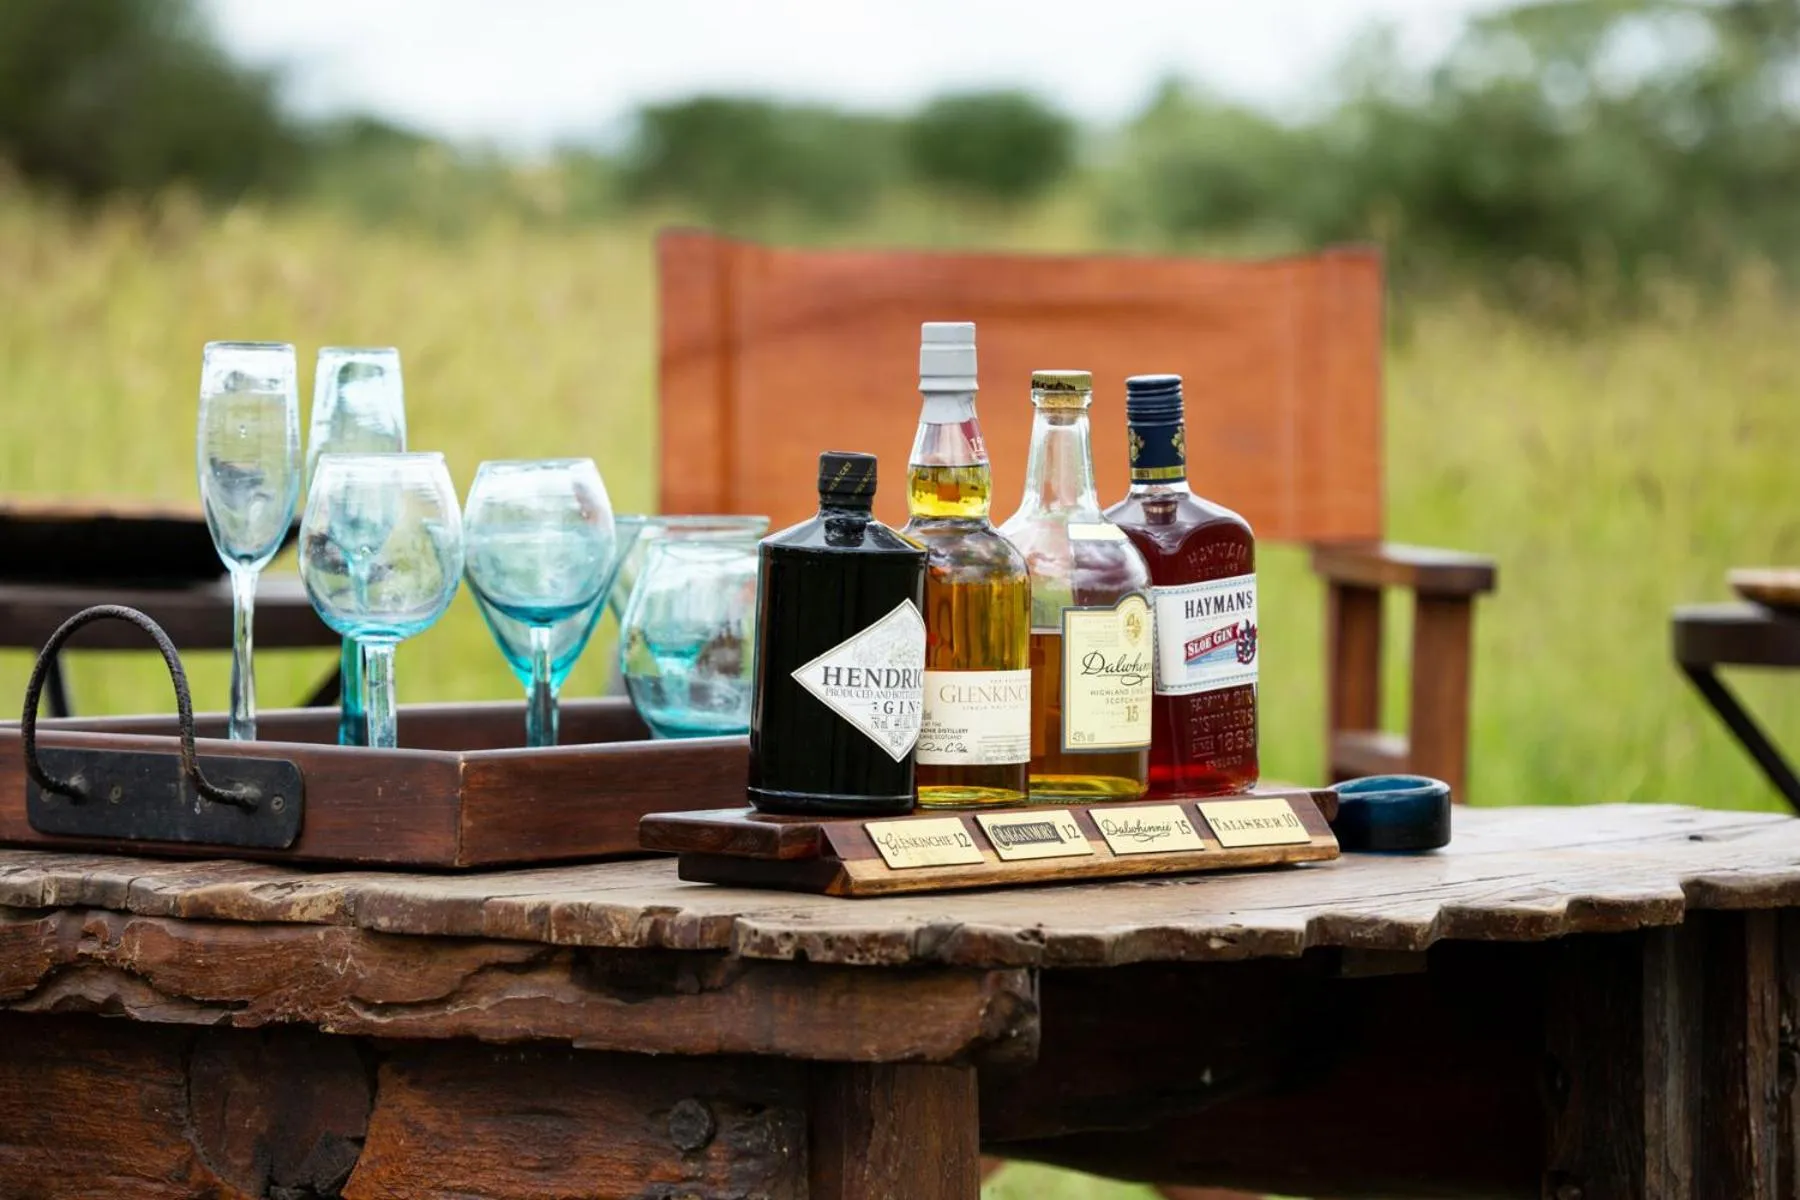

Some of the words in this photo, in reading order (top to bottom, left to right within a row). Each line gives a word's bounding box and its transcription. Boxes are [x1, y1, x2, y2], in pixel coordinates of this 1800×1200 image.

[1212, 628, 1234, 647] GIN
[883, 700, 916, 715] GIN
[1126, 705, 1140, 723] 15
[1174, 820, 1192, 836] 15
[1210, 816, 1281, 833] TALISKER
[1281, 813, 1298, 828] 10
[1062, 824, 1081, 840] 12
[953, 833, 972, 848] 12
